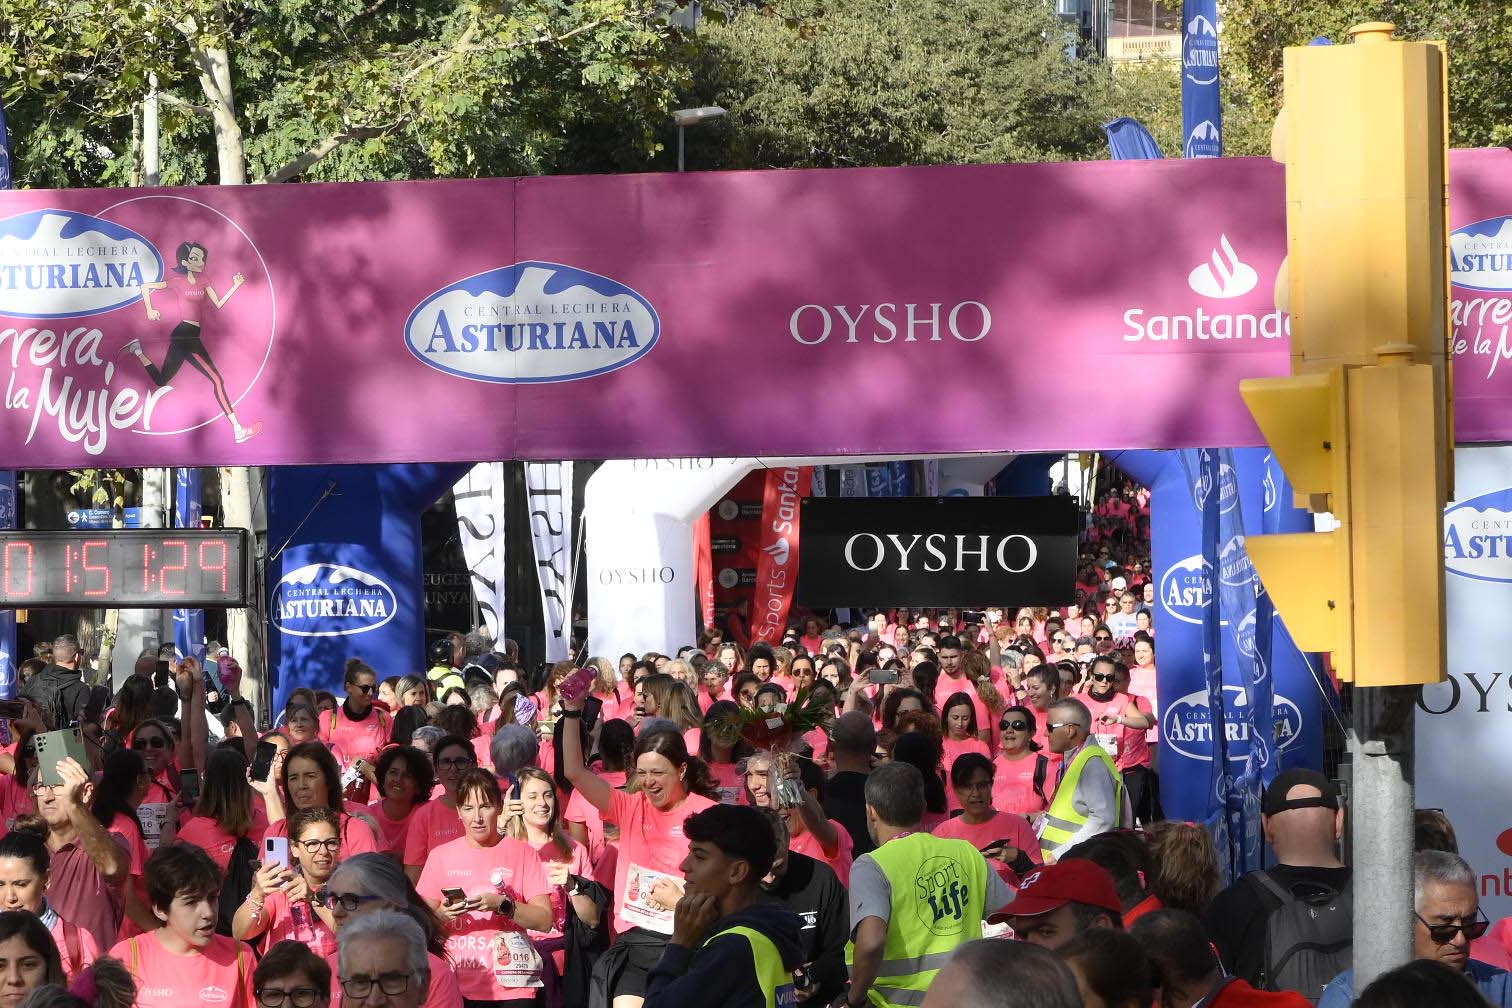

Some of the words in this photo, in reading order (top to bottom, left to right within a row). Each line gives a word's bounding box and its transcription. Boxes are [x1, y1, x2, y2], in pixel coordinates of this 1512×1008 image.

[64, 244, 140, 256] LECHERA
[1464, 241, 1512, 250] CENTRA
[464, 303, 543, 318] CENTRAL
[551, 302, 633, 316] LECHERA
[788, 300, 993, 345] OYSHO
[1122, 307, 1290, 341] Santand
[424, 308, 641, 354] ASTURIANA
[5, 372, 30, 411] la
[24, 362, 174, 455] Mujer
[772, 466, 800, 536] Santa
[1471, 520, 1512, 530] CENT
[844, 533, 1038, 573] OYSHO
[287, 589, 332, 597] CENTRAL
[335, 587, 383, 596] LECHERA
[599, 566, 676, 586] OYSHO
[277, 595, 388, 620] ASTURIANA
[758, 569, 786, 638] Sports
[916, 860, 960, 900] Sport
[928, 880, 969, 924] Life
[513, 953, 530, 961] 016
